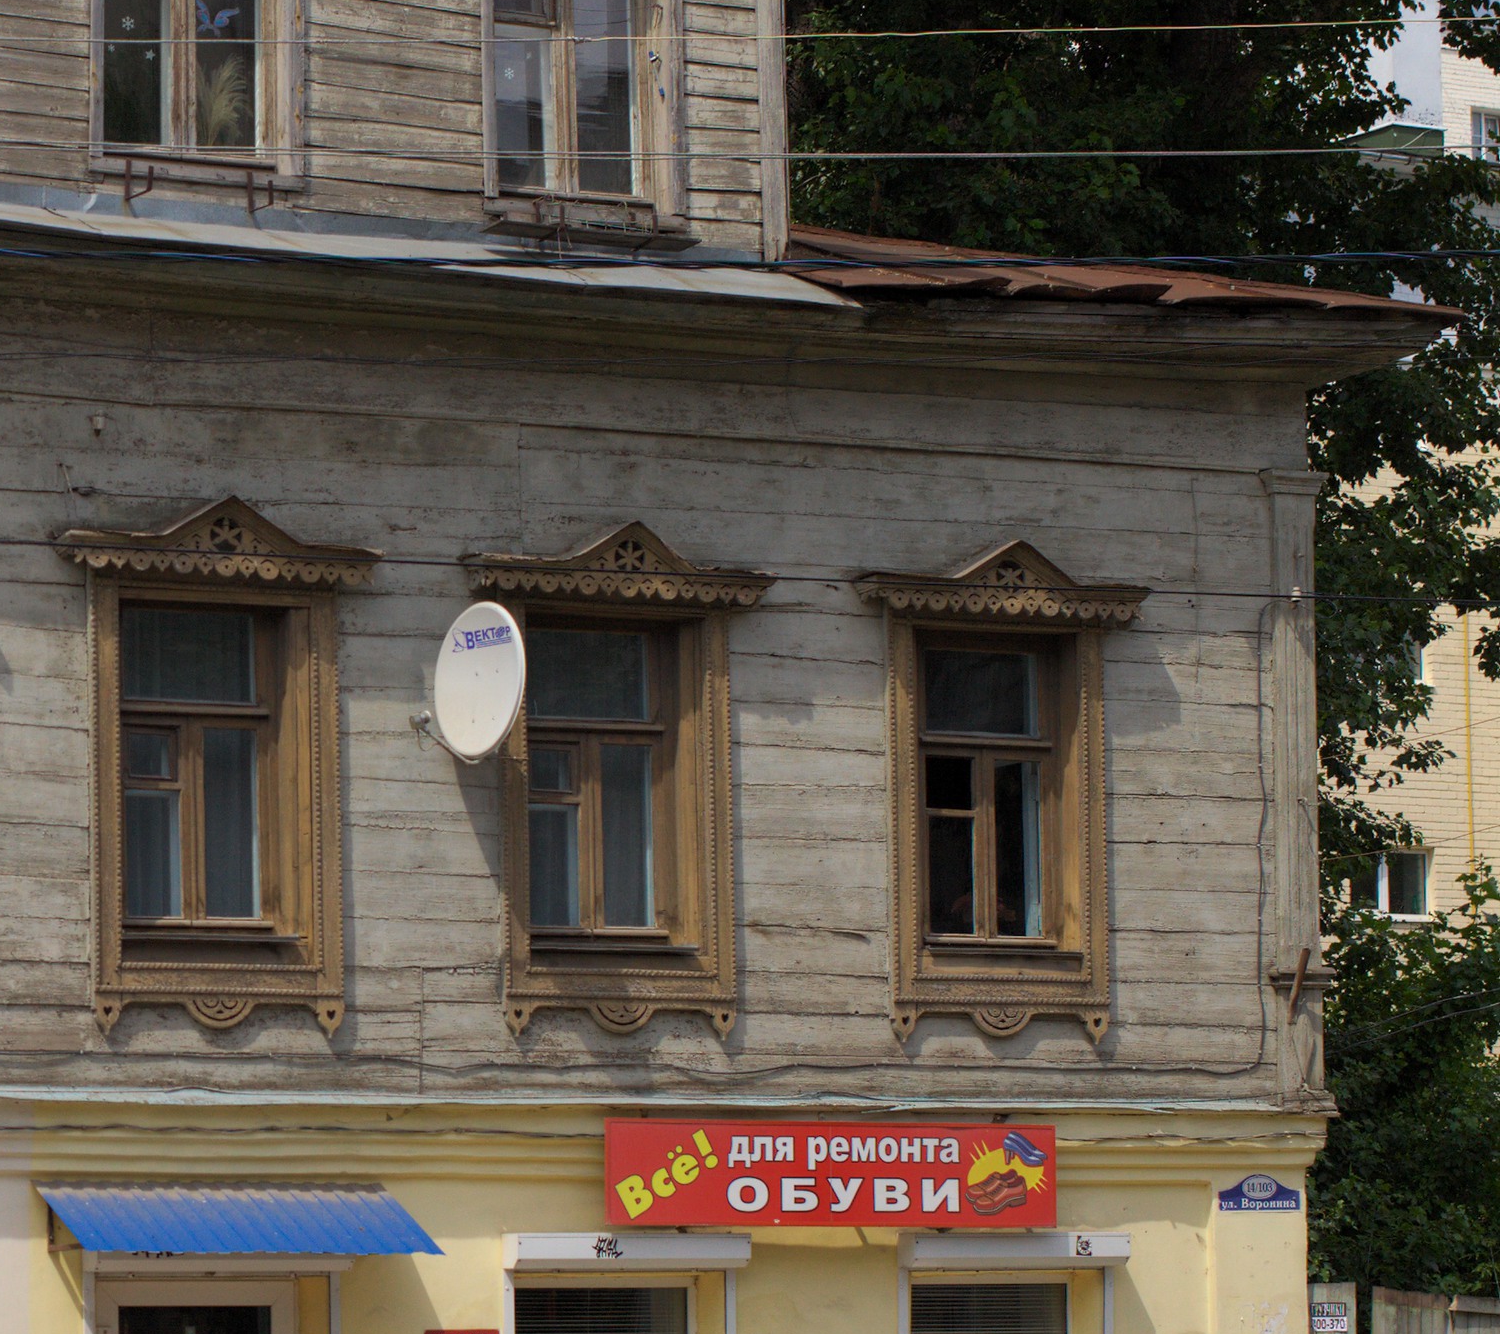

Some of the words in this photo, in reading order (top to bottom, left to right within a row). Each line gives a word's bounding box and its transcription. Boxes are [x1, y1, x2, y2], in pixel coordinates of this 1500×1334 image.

[727, 1134, 795, 1169] для
[806, 1135, 961, 1171] ремонта
[615, 1128, 720, 1220] Всё!
[1246, 1182, 1273, 1193] 14/103
[726, 1176, 961, 1213] ОБУВИ
[1221, 1201, 1237, 1210] ул.
[1241, 1198, 1296, 1210] Воронина
